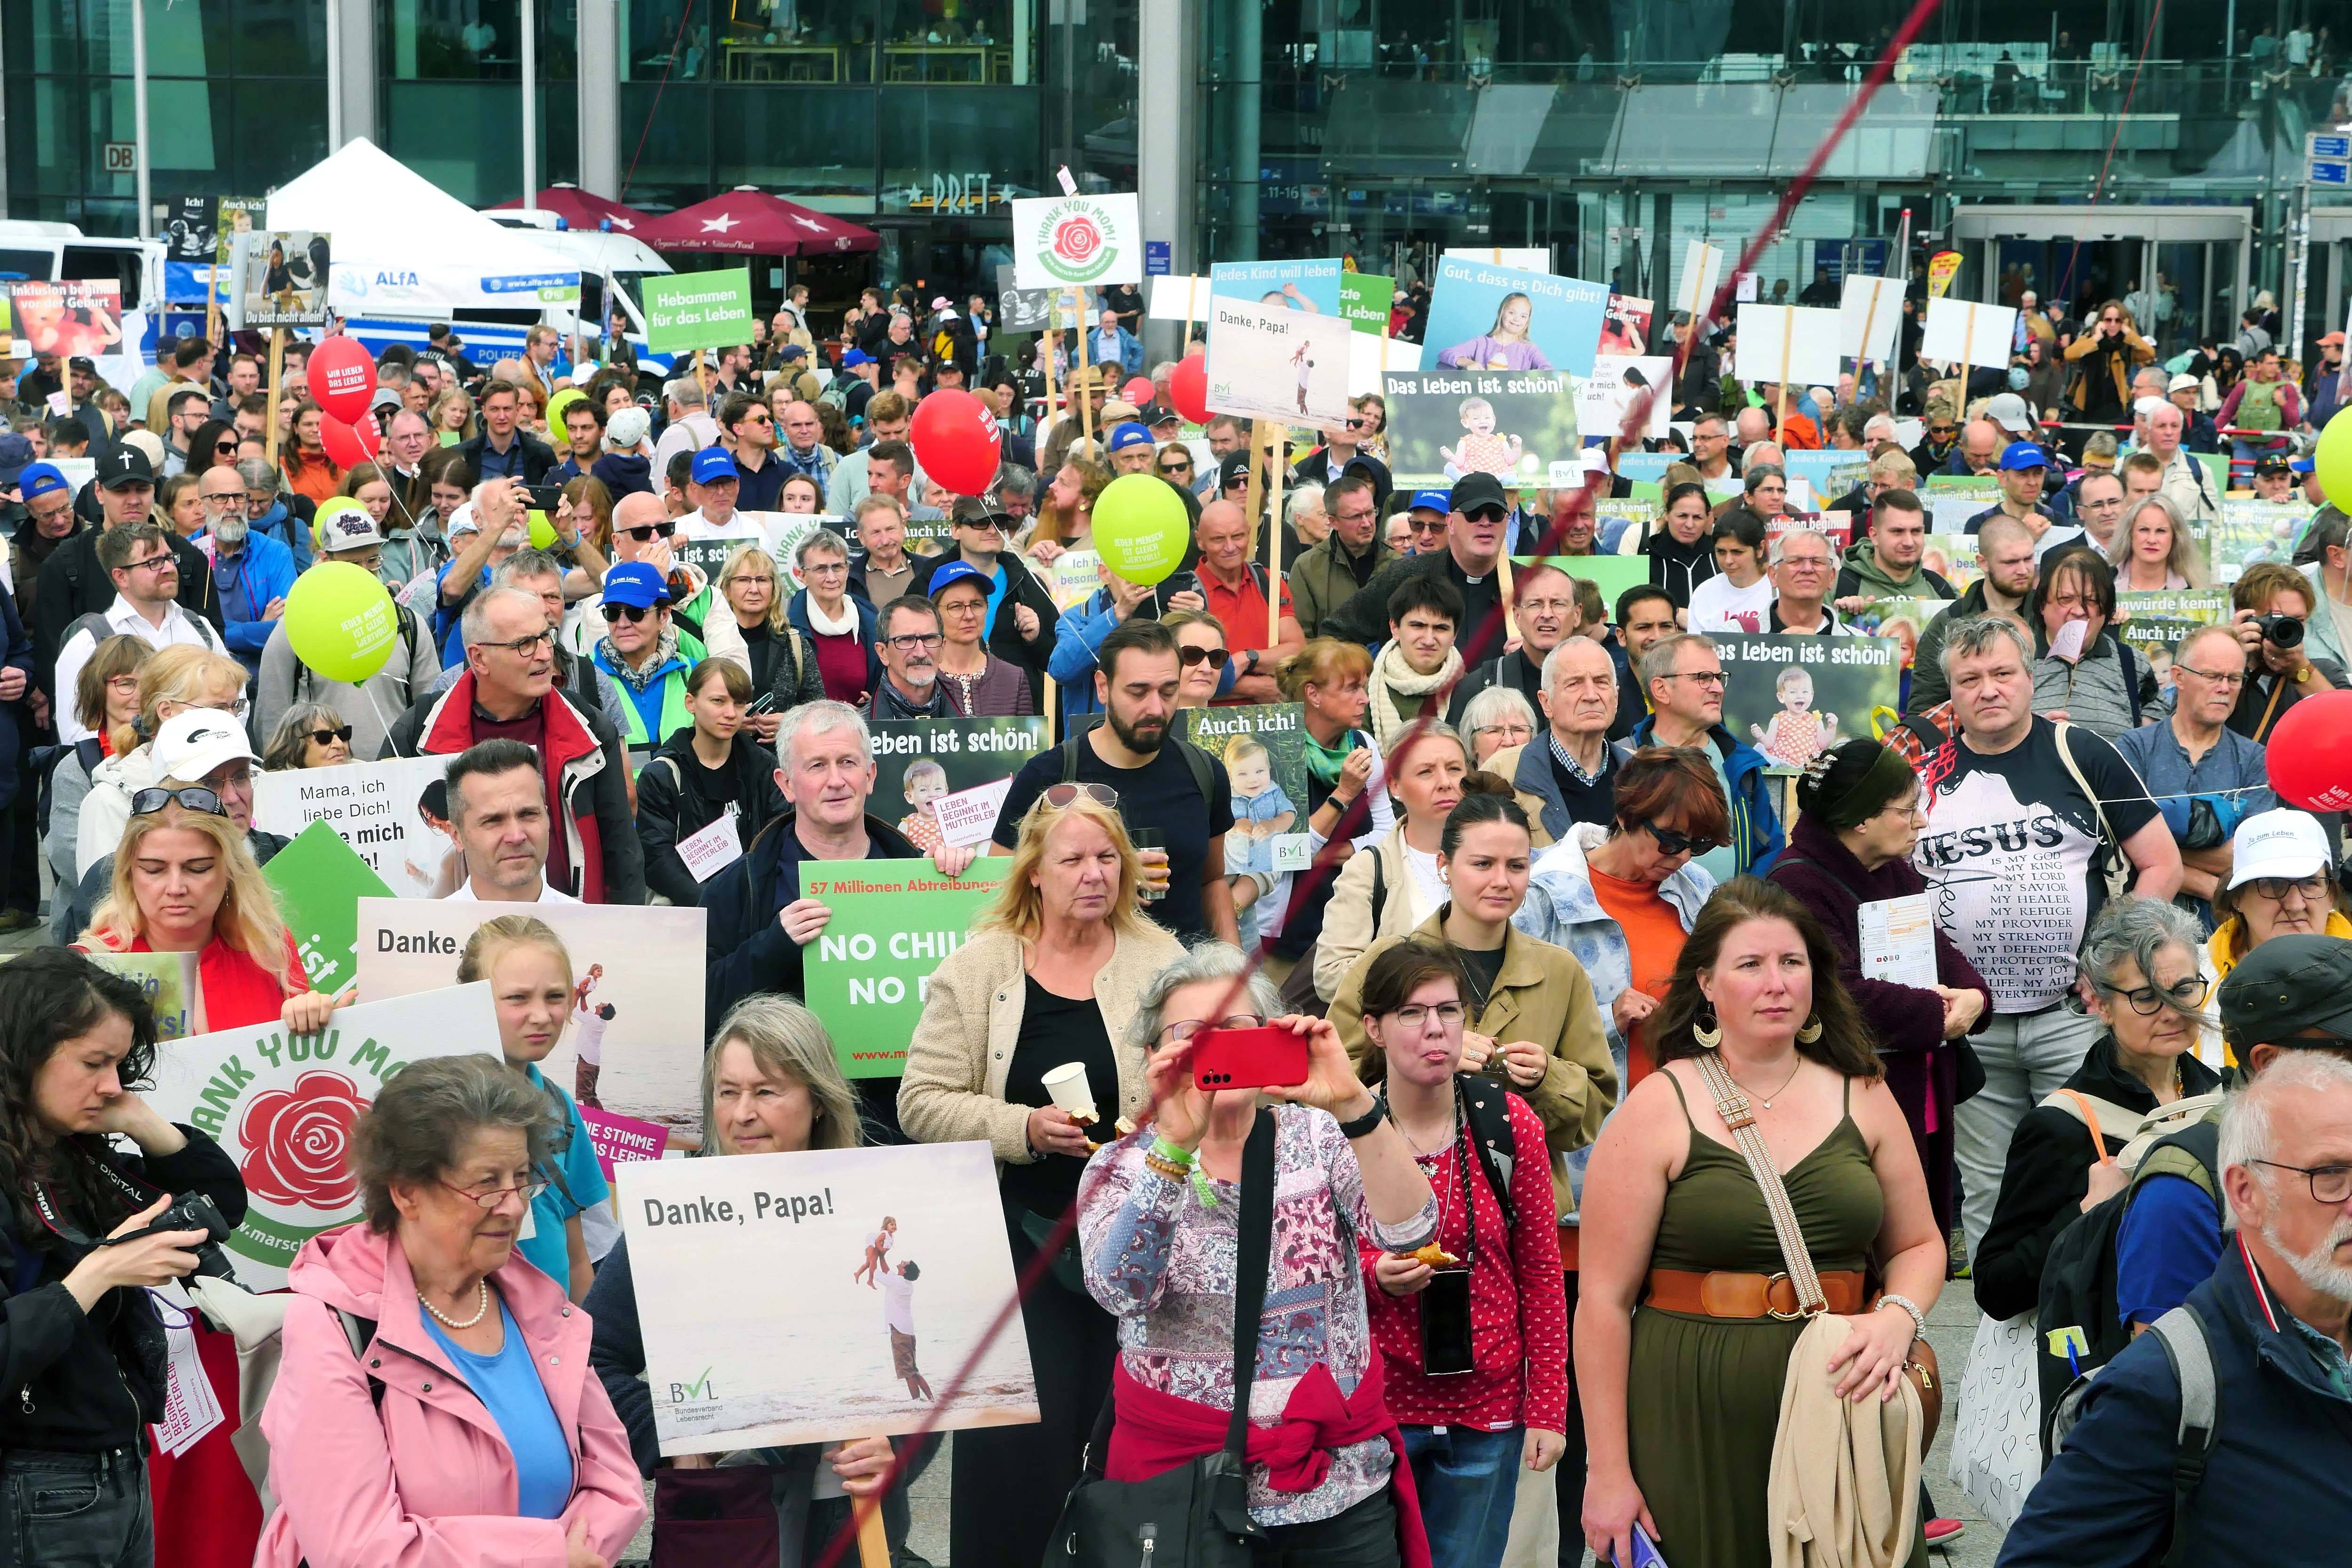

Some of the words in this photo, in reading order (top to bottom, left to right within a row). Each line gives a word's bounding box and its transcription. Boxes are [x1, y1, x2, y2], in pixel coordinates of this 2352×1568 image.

[109, 147, 133, 167] DB
[933, 174, 992, 215] PRET
[1268, 187, 1298, 198] 11-16
[185, 197, 204, 207] Ich!
[224, 200, 246, 209] Auch
[249, 202, 265, 210] ich!
[1038, 205, 1063, 245] THANK
[1064, 199, 1090, 213] YOU
[1092, 206, 1116, 241] MOM!
[376, 272, 419, 285] ALfA
[1215, 268, 1247, 281] Jedes
[1251, 267, 1277, 280] Kind
[1280, 265, 1302, 278] will
[1304, 264, 1337, 277] leben
[13, 284, 66, 296] Inklusion
[508, 277, 563, 287] www.alfa-ev.de
[1444, 264, 1473, 282] Gut,
[1477, 268, 1507, 288] dass
[1512, 278, 1527, 291] es
[1532, 275, 1561, 296] Dich
[1566, 283, 1600, 305] gibt!
[21, 300, 43, 308] vor
[46, 298, 64, 308] der
[67, 297, 109, 308] Geburt
[657, 289, 737, 307] Hebammen
[1341, 289, 1360, 300] zte
[1610, 297, 1650, 312] beginnt
[245, 311, 261, 323] Du
[261, 311, 277, 323] bist
[278, 311, 301, 323] nicht
[302, 311, 328, 323] allein!
[652, 312, 671, 327] für
[676, 308, 702, 324] das
[705, 306, 746, 322] Leben
[1346, 305, 1385, 321] Leben
[1605, 309, 1641, 324] Geburt
[1220, 311, 1255, 330] Danke,
[1260, 318, 1288, 334] Papa!
[327, 369, 339, 378] WIR
[341, 365, 363, 376] LIEBEN
[329, 378, 342, 387] DAS
[344, 374, 365, 386] LEBEN!
[1388, 378, 1417, 395] Das
[1423, 377, 1472, 394] Leben
[1478, 377, 1502, 394] ist
[1508, 376, 1564, 394] schön!
[1790, 454, 1815, 463] Jedes
[1843, 453, 1860, 462] will
[1974, 489, 2002, 499] kennt
[1618, 502, 1652, 513] kennt
[2223, 504, 2304, 514] Menschenwürde
[1764, 517, 1806, 530] nklusion
[1809, 517, 1849, 533] beginnt
[2224, 515, 2244, 524] kein
[776, 523, 806, 564] THANK
[1114, 538, 1133, 547] JEDER
[1136, 531, 1163, 545] MENSCH
[684, 549, 705, 562] ist
[1122, 548, 1134, 556] IST
[1136, 543, 1159, 555] GLEICH
[1073, 558, 1089, 568] Ich
[1124, 552, 1160, 564] WERTVOLL!
[1061, 574, 1099, 585] besond
[2115, 596, 2176, 611] enwürde
[2180, 595, 2222, 610] kennt
[340, 616, 362, 632] JEDER
[363, 599, 387, 620] MENSCH
[352, 626, 365, 639] IST
[366, 615, 386, 632] GLEICH
[2125, 625, 2164, 640] Auch
[356, 624, 390, 648] WERTVOLL!
[1743, 644, 1793, 662] Leben
[1800, 645, 1824, 662] ist
[1831, 644, 1891, 665] schön!
[1198, 715, 1251, 735] Auch
[1256, 713, 1296, 732] ich!
[871, 730, 922, 755] eben
[931, 729, 960, 753] ist
[968, 726, 1038, 752] schön!
[300, 785, 356, 802] Mama,
[362, 780, 385, 794] ich
[2318, 793, 2339, 805] DAS
[2329, 785, 2347, 801] WIR
[304, 808, 343, 823] liebe
[349, 803, 391, 817] Dich!
[940, 797, 968, 813] LEBEN
[943, 804, 979, 822] BEGINNT
[981, 801, 990, 810] IM
[945, 809, 996, 831] MUTTERLEIB
[358, 824, 404, 843] mich
[1918, 815, 2066, 867] JESUS
[682, 837, 703, 854] LEBEN
[686, 840, 713, 861] BEGINNT
[712, 835, 721, 846] IM
[690, 840, 729, 868] MUTTERLEIB
[1991, 857, 2002, 865] IS
[2007, 854, 2027, 864] MY
[2033, 851, 2060, 861] GOD
[2005, 863, 2026, 872] MY
[2031, 861, 2062, 871] KING
[2006, 872, 2026, 881] MY
[2032, 872, 2065, 881] LORD
[809, 882, 829, 895] 57
[833, 879, 903, 894] Millionen
[1993, 883, 2013, 892] MY
[2020, 882, 2068, 892] SAVIOR
[1990, 895, 2012, 904] MY
[2017, 894, 2070, 904] HEALER
[1991, 907, 2012, 916] MY
[2020, 906, 2073, 916] REFUGE
[1975, 920, 1995, 929] MY
[2002, 919, 2073, 928] PROVIDER
[378, 928, 465, 959] Danke,
[1973, 933, 1992, 942] MY
[1998, 931, 2073, 942] STRENGTH
[820, 933, 876, 962] NO
[1977, 945, 1997, 954] MY
[2003, 944, 2070, 954] DEFENDER
[298, 934, 339, 984] ist
[1969, 956, 1987, 965] MY
[1991, 955, 2070, 965] PROTECTOR
[1975, 966, 2019, 976] PEACE.
[2025, 966, 2044, 976] MY
[2048, 963, 2069, 976] JOY
[849, 976, 906, 1005] NO
[1990, 978, 2018, 988] LIFE.
[2023, 978, 2043, 987] MY
[2049, 977, 2071, 986] ALL
[256, 1029, 340, 1068] YOU
[603, 1126, 656, 1152] STIMME
[100, 1164, 142, 1202] DIGITAL
[644, 1196, 744, 1227] Danke,
[753, 1187, 835, 1224] Papa!
[167, 1361, 192, 1430] MUTTERLEIB
[674, 1404, 723, 1415] Bundesverband
[676, 1413, 714, 1423] Lebensrecht
